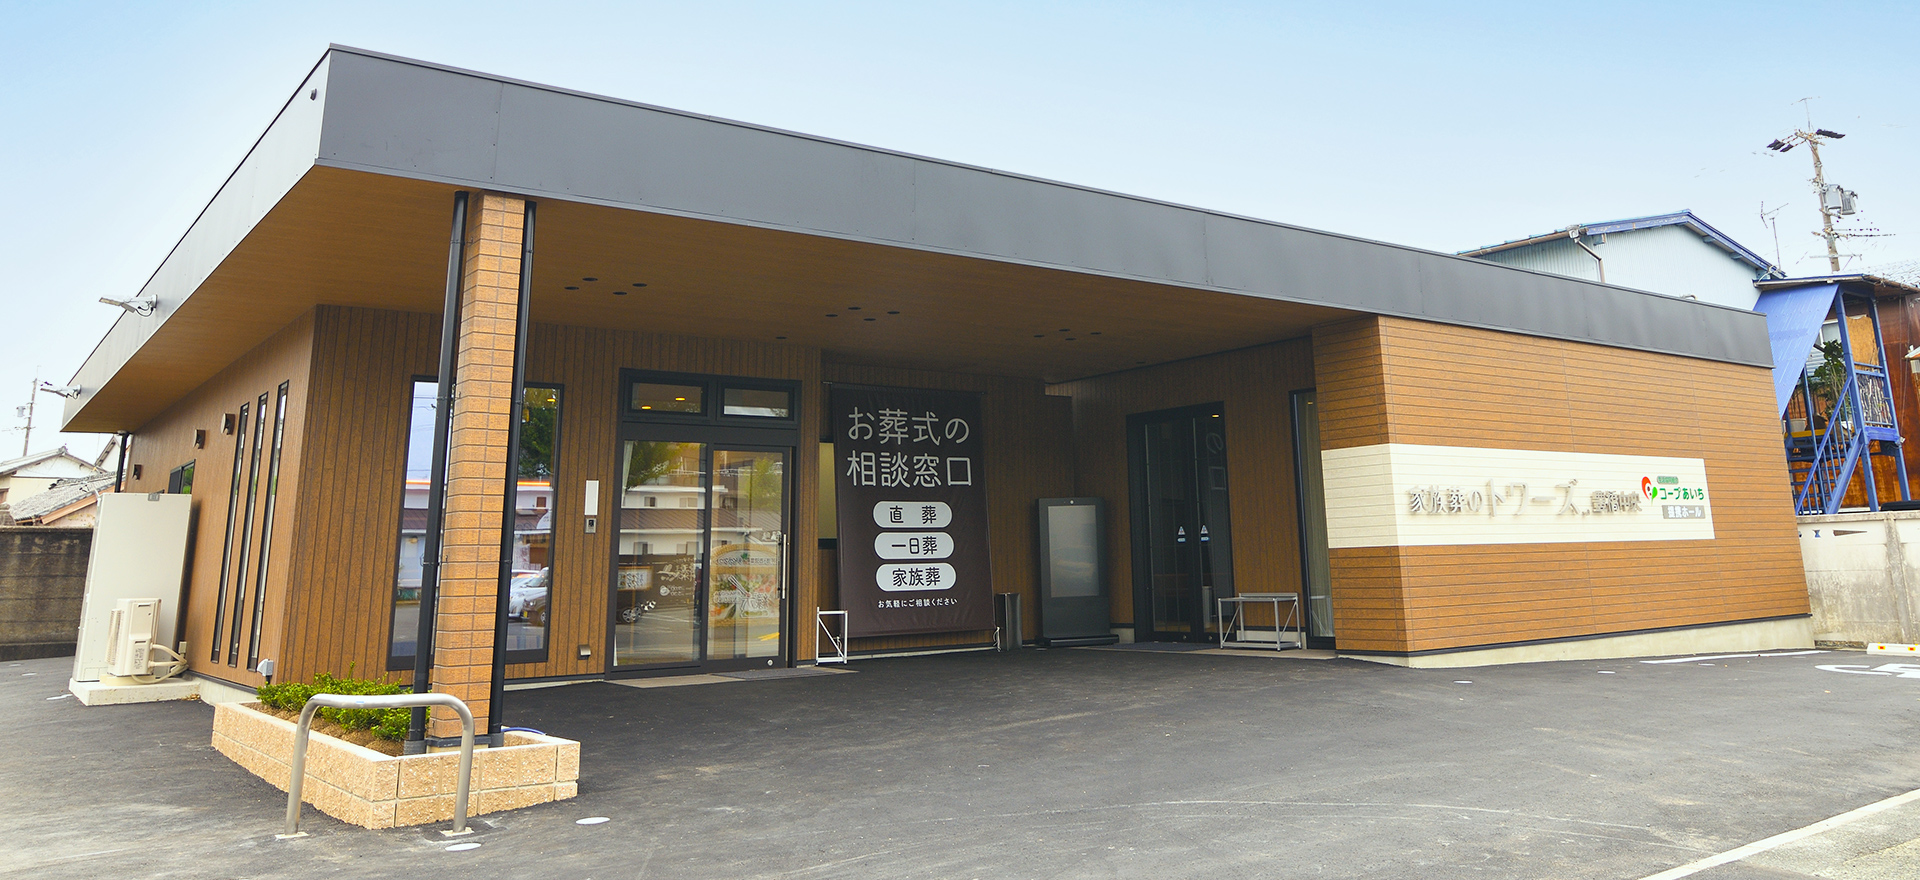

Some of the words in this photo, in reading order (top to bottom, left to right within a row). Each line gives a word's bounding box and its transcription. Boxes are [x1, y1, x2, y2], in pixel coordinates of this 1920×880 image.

[848, 406, 970, 446] お葬式の
[846, 450, 972, 488] 相談窓口
[1659, 486, 1705, 500] コープあいち
[891, 536, 938, 555] 一日葬
[892, 567, 941, 587] 家族葬
[878, 597, 958, 609] お気軽にご相談ください
